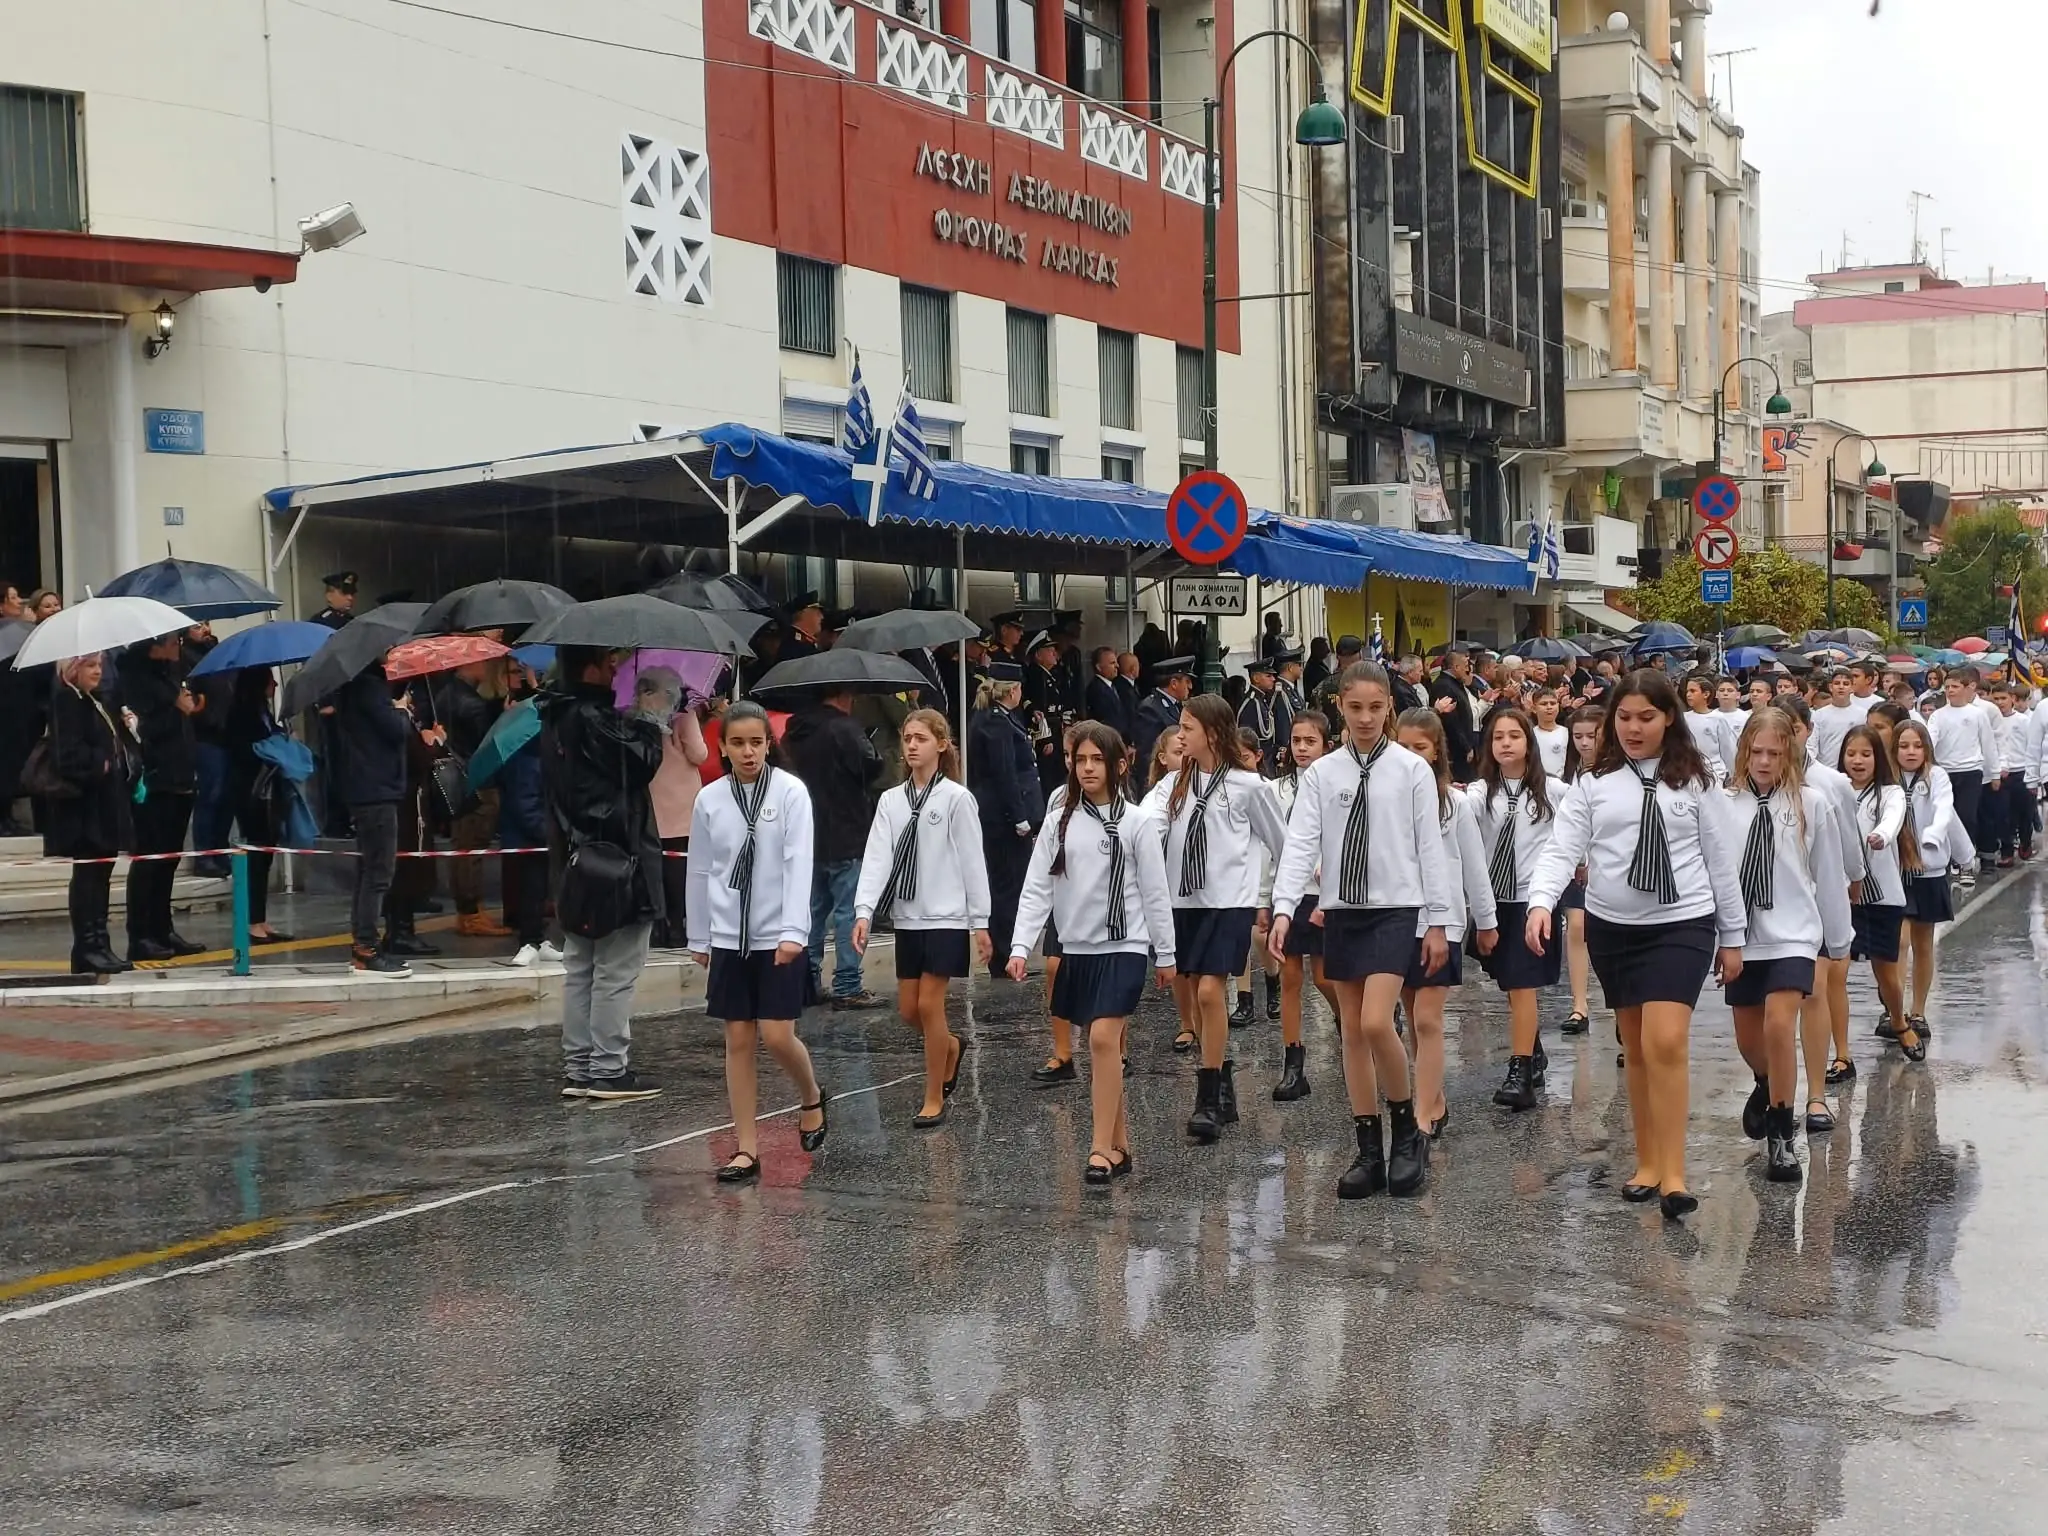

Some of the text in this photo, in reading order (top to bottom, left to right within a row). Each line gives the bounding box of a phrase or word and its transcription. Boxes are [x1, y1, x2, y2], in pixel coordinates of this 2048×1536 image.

[916, 141, 1132, 238] ΛΕΣΧΗ ΑΞΙΩΜΑΤΙΚΩΝ
[934, 207, 1120, 288] ΦΡΟΥΡΑΣ ΛΑΡΙΣΑΣ
